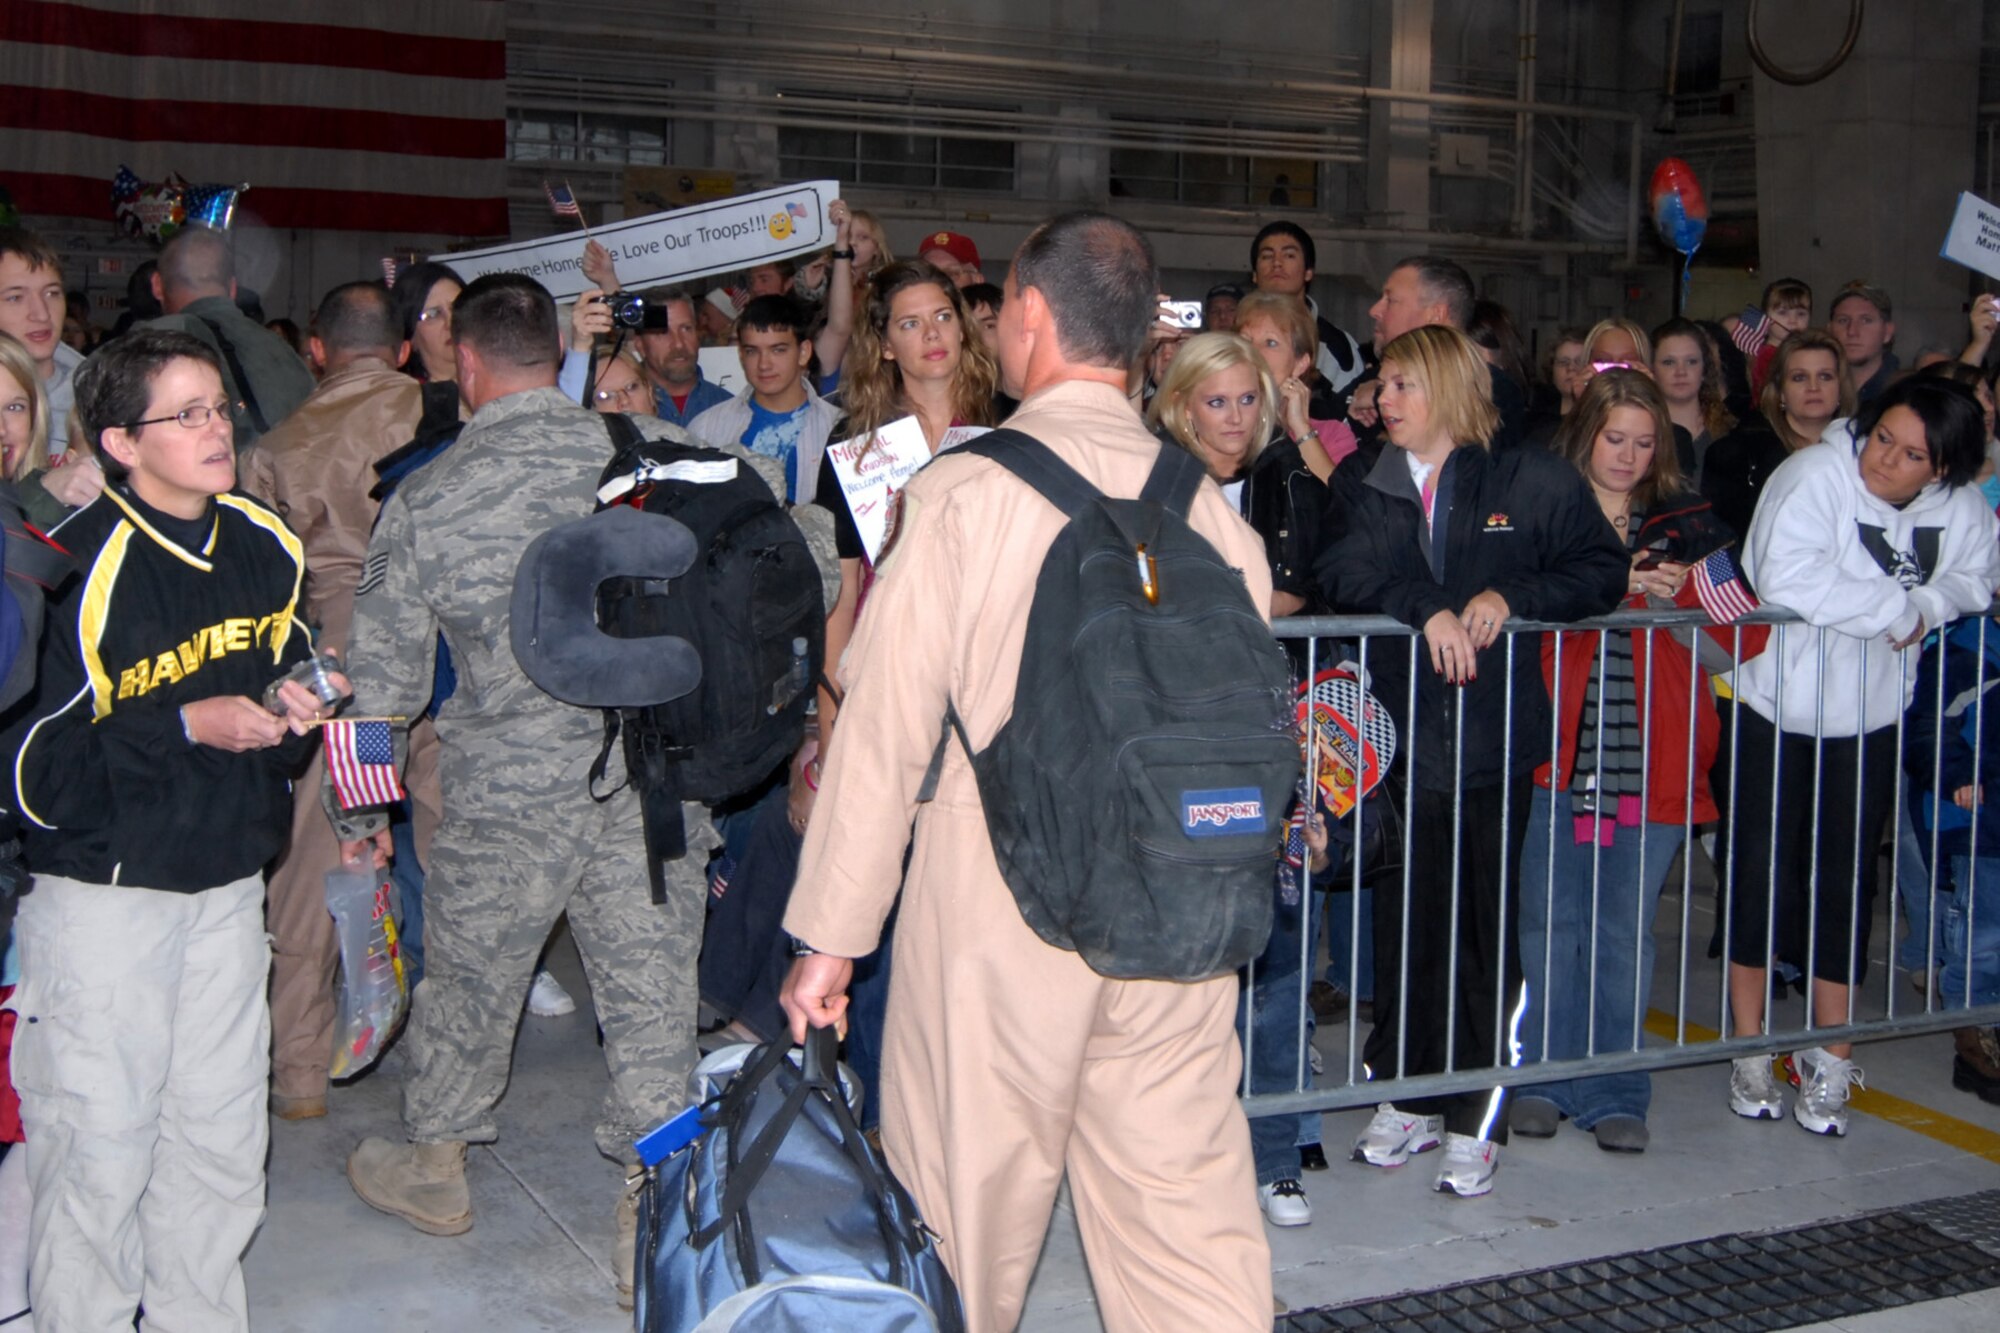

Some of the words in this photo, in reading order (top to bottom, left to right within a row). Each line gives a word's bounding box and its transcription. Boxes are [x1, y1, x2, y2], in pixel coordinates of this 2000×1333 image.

[623, 238, 660, 260] Love
[664, 231, 693, 252] Our
[697, 213, 768, 244] Troops!!!
